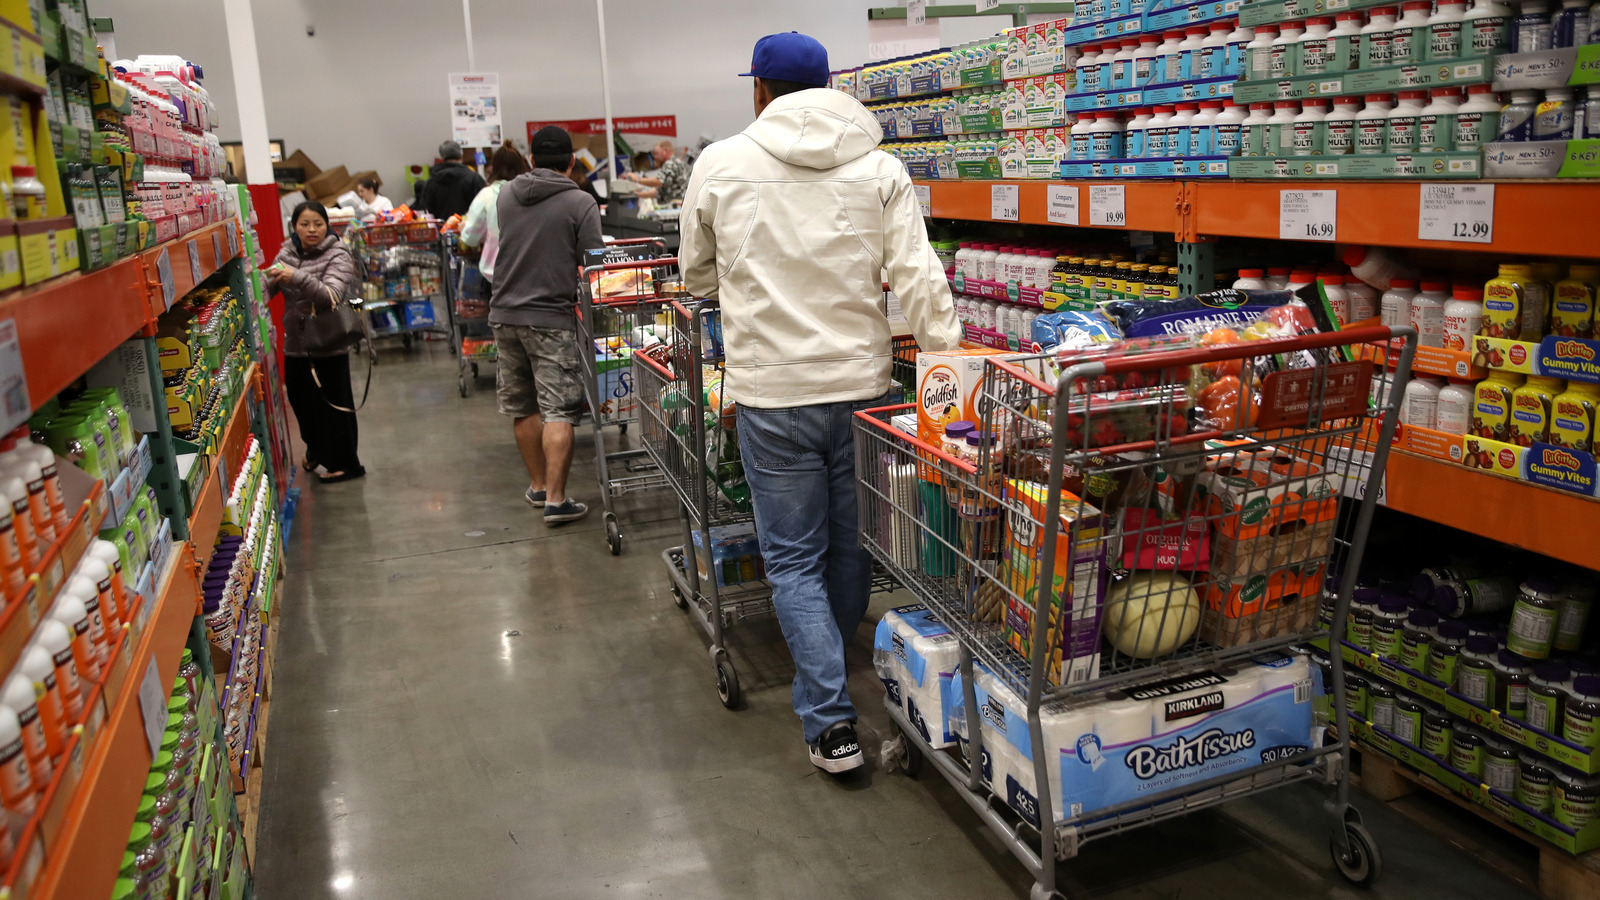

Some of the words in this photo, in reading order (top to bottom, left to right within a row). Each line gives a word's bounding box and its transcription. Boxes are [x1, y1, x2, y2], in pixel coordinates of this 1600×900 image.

[1291, 8, 1308, 16] MULTI
[1431, 43, 1459, 52] MULTI
[1548, 59, 1564, 68] 50+
[1285, 89, 1302, 97] MULTI
[617, 121, 649, 130] Novato
[652, 120, 672, 128] #141
[1539, 148, 1556, 157] 50+
[1571, 152, 1577, 160] 6
[1428, 187, 1454, 195] 1339412
[1004, 208, 1017, 218] 21.99
[1106, 212, 1123, 222] 19.99
[1306, 224, 1333, 236] 16.99
[1453, 222, 1488, 237] 12.99
[1161, 312, 1240, 335] ROMAINE
[1543, 357, 1579, 372] Gummy
[924, 383, 957, 408] Goldfish
[1530, 464, 1566, 480] Gummy
[1567, 472, 1591, 485] Vites
[1536, 475, 1555, 483] COMPLETE
[1135, 675, 1222, 699] KIRKLAND
[1168, 694, 1222, 715] KIRKLAND
[1567, 708, 1591, 719] KIRKLAND
[1499, 724, 1526, 740] Children's
[832, 743, 858, 756] adidas
[1142, 780, 1164, 791] Layers
[1173, 770, 1198, 781] Softness
[1211, 757, 1247, 770] Absorbency
[1016, 791, 1035, 815] 425
